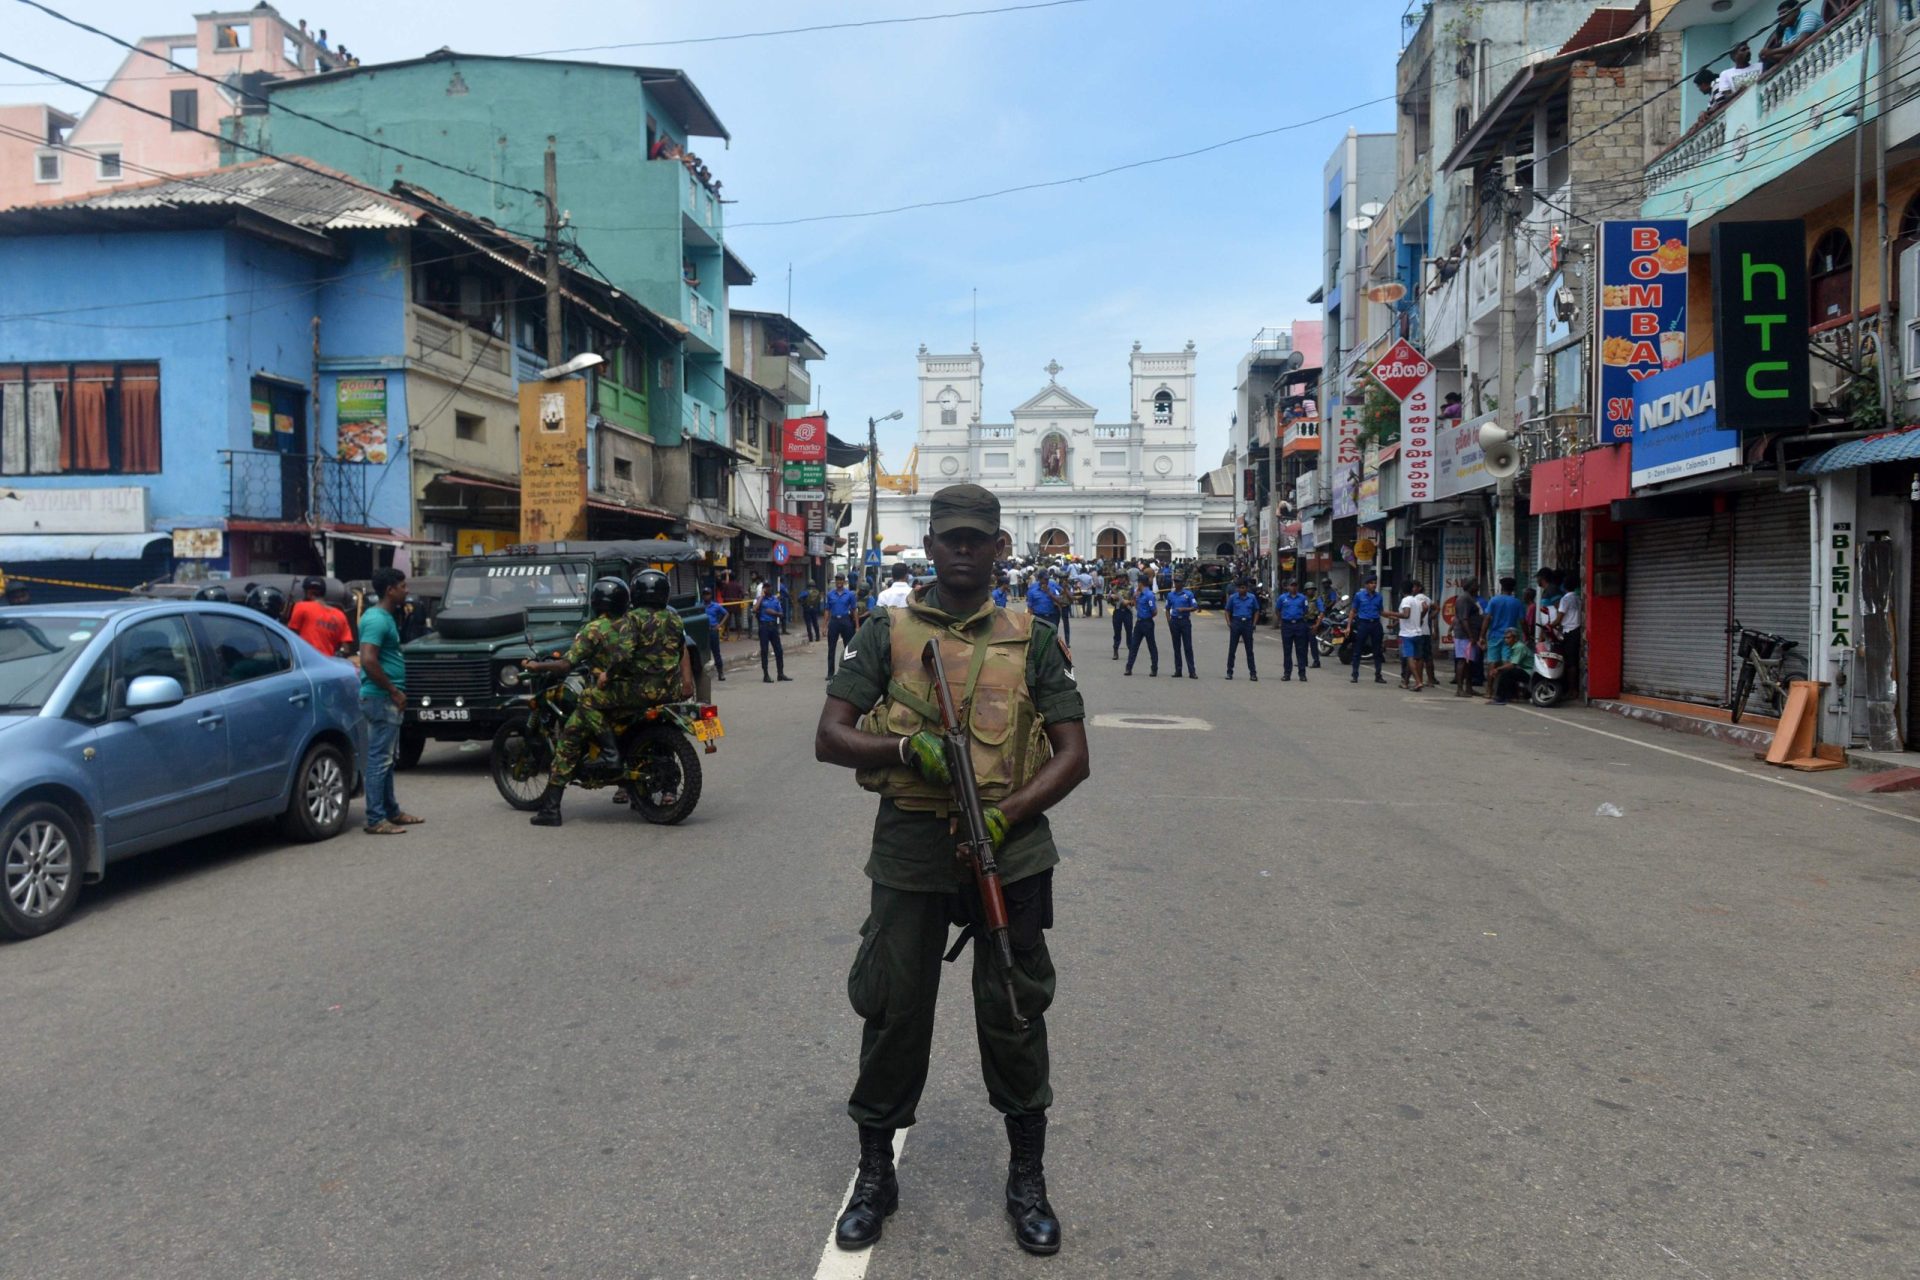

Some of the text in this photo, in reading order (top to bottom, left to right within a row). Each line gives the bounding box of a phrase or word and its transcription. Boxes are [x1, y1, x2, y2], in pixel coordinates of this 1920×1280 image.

[1639, 380, 1716, 432] NOKIA
[488, 566, 551, 577] DEFENDER
[1831, 534, 1850, 646] BISMILLA
